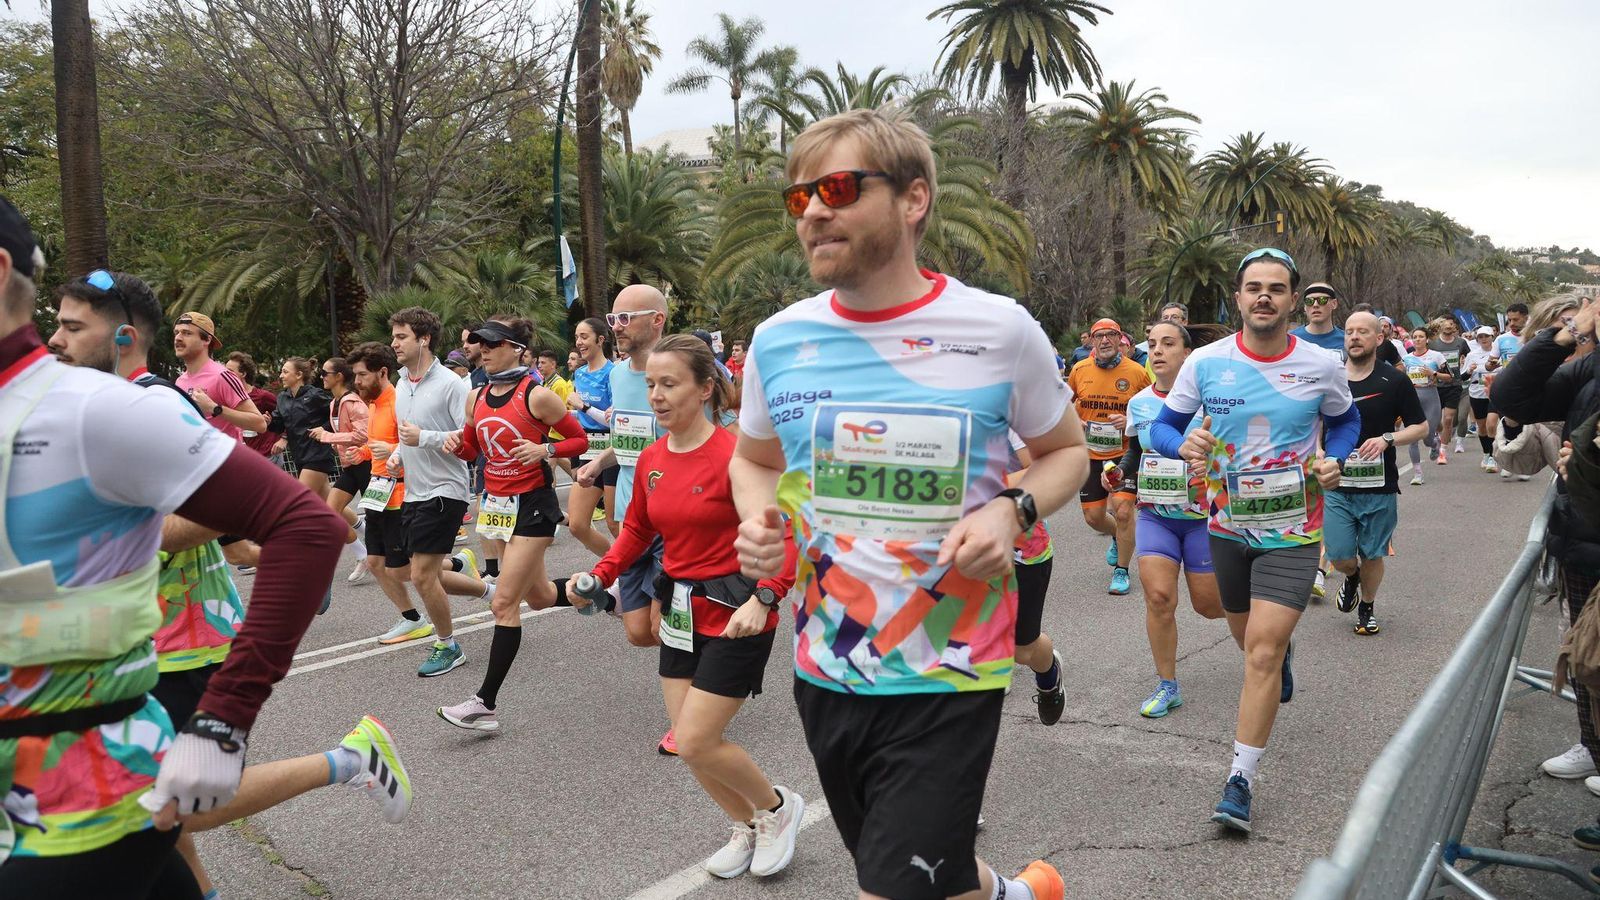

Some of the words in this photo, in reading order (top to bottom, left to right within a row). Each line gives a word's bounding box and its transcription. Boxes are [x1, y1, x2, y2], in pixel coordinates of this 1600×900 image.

[769, 407, 805, 428] 025
[617, 435, 647, 450] 5187
[907, 442, 942, 451] MARATÓN
[1097, 436, 1116, 446] 4634
[1345, 466, 1377, 478] 5189
[845, 465, 940, 503] 5183
[1146, 477, 1178, 491] 5855
[1246, 495, 1294, 514] 4732
[486, 513, 513, 529] 3618
